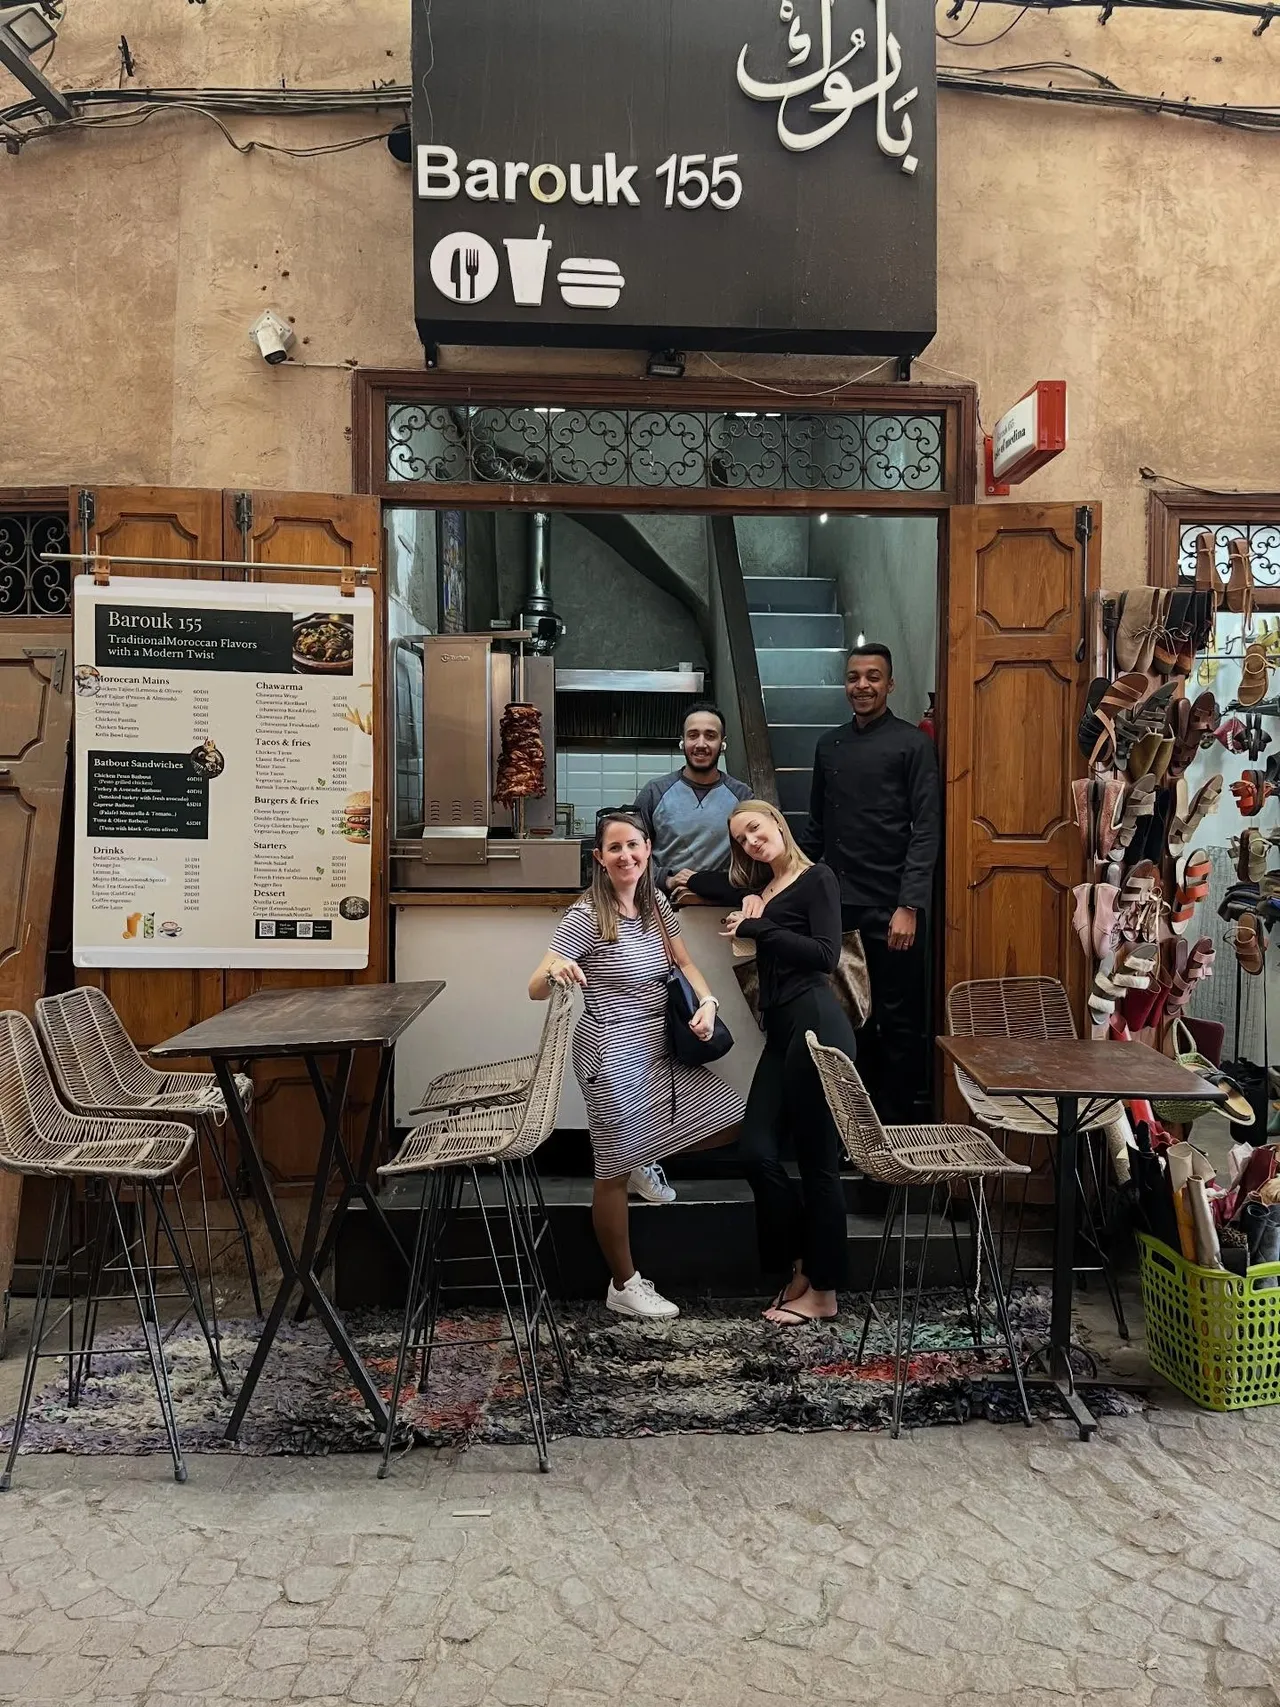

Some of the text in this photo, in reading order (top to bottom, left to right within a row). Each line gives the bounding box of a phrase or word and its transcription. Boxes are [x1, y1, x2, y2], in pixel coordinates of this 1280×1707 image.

[416, 144, 742, 210] Barouk 155
[108, 611, 202, 632] Barouk 155
[220, 639, 258, 649] Flavors
[108, 647, 130, 656] with
[142, 648, 183, 658] Modern
[186, 650, 214, 659] Twist
[95, 675, 169, 685] Moroccan Mains
[256, 682, 303, 690] Chawarma
[256, 738, 280, 746] Tacos
[94, 759, 183, 769] Batbout Sandwiches
[255, 797, 288, 805] Burgers
[300, 797, 319, 805] fries
[94, 846, 124, 854] Drinks
[254, 842, 287, 850] Starters
